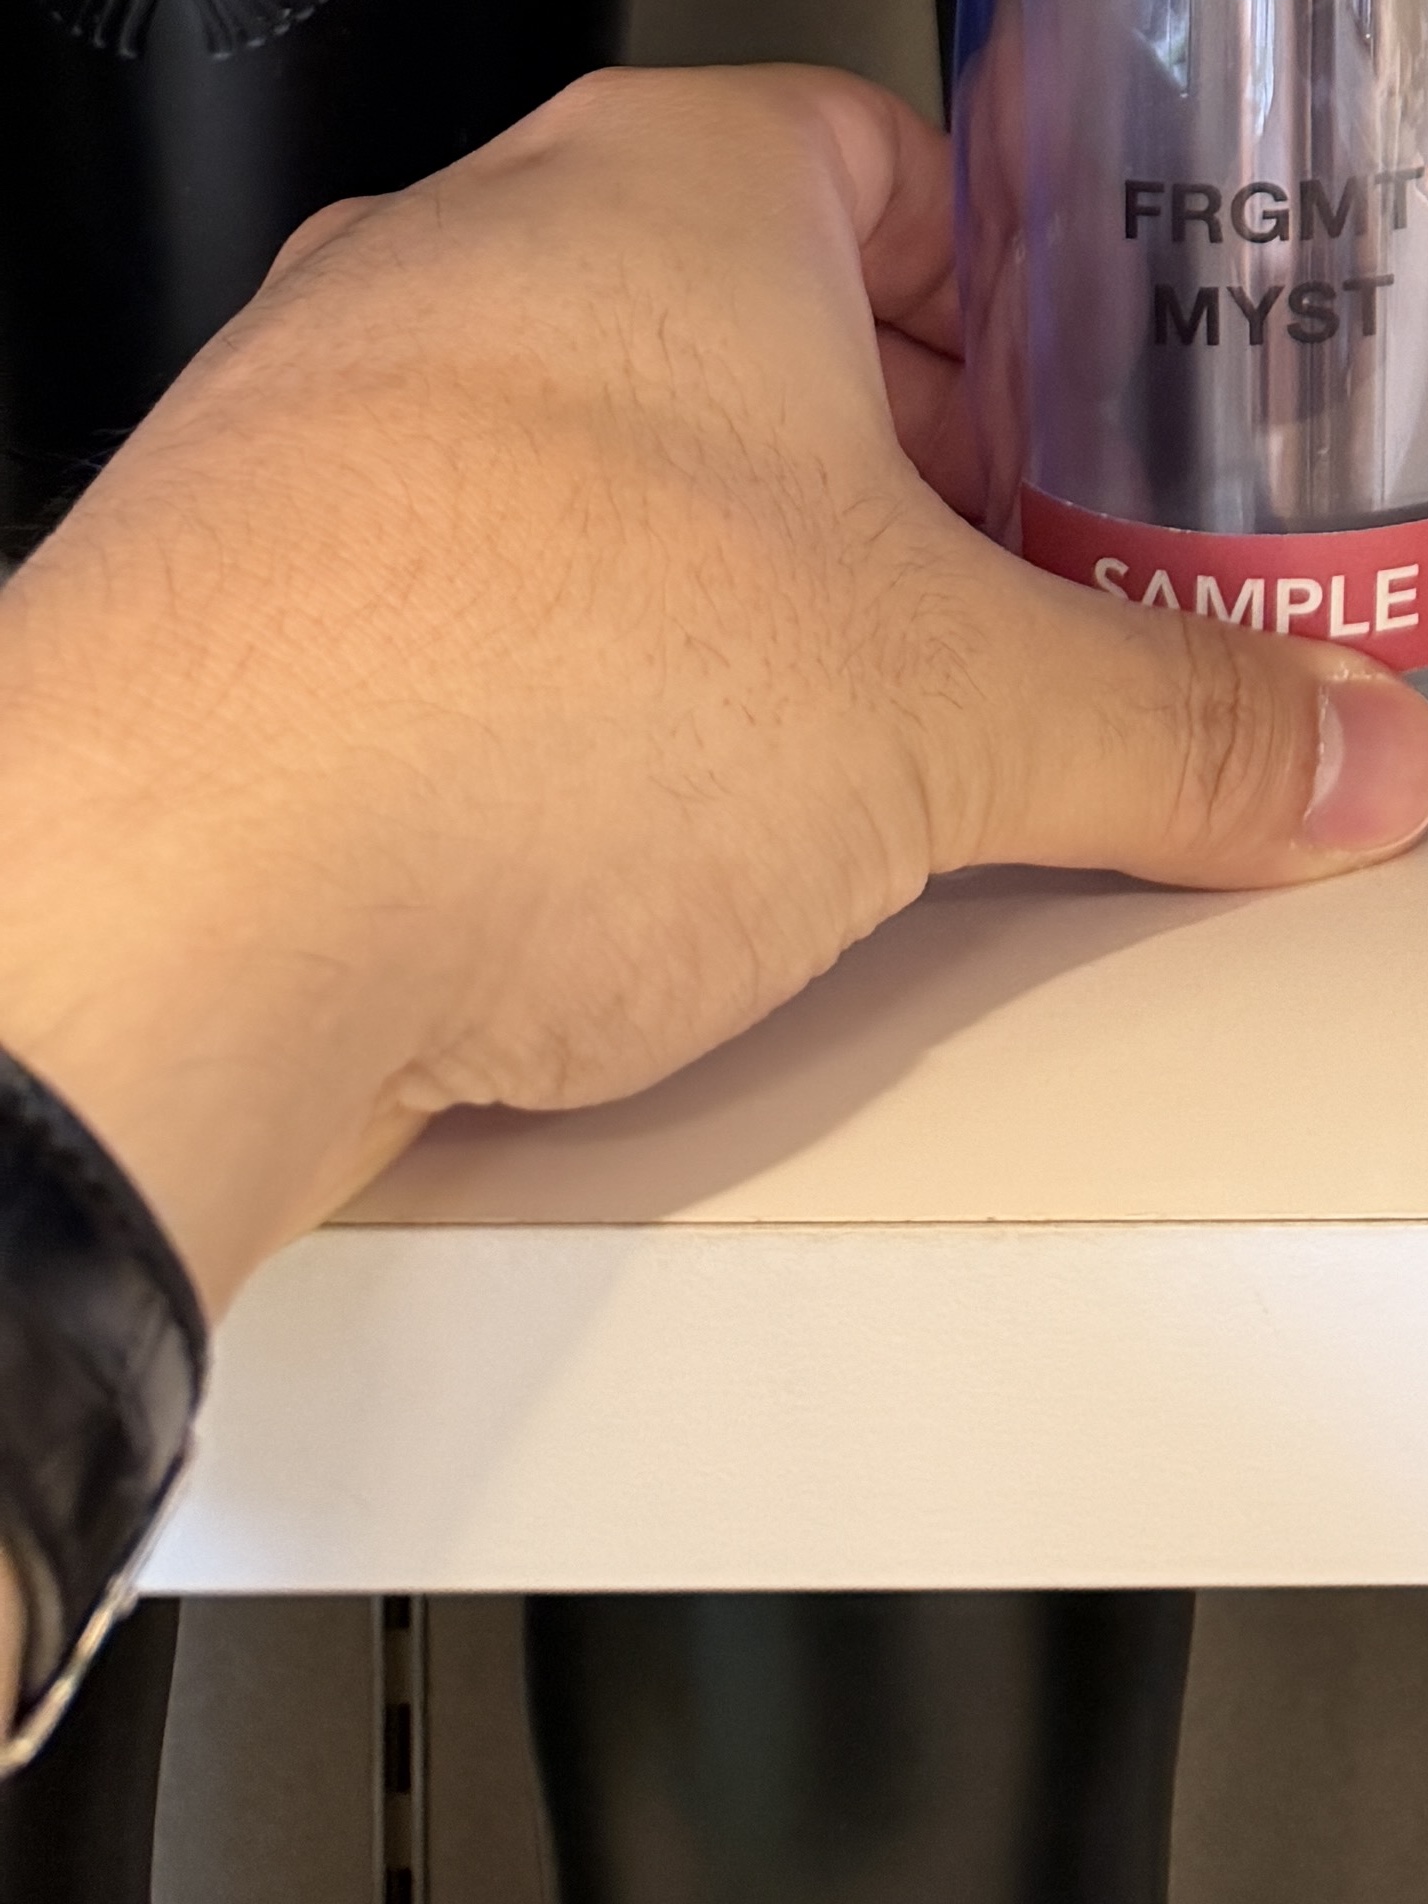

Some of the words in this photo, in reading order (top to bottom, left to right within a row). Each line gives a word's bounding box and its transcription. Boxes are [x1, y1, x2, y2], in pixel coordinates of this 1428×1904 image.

[1124, 165, 1424, 244] FRGMT
[1152, 273, 1395, 346] MYST
[1095, 557, 1419, 638] SAMPLE
